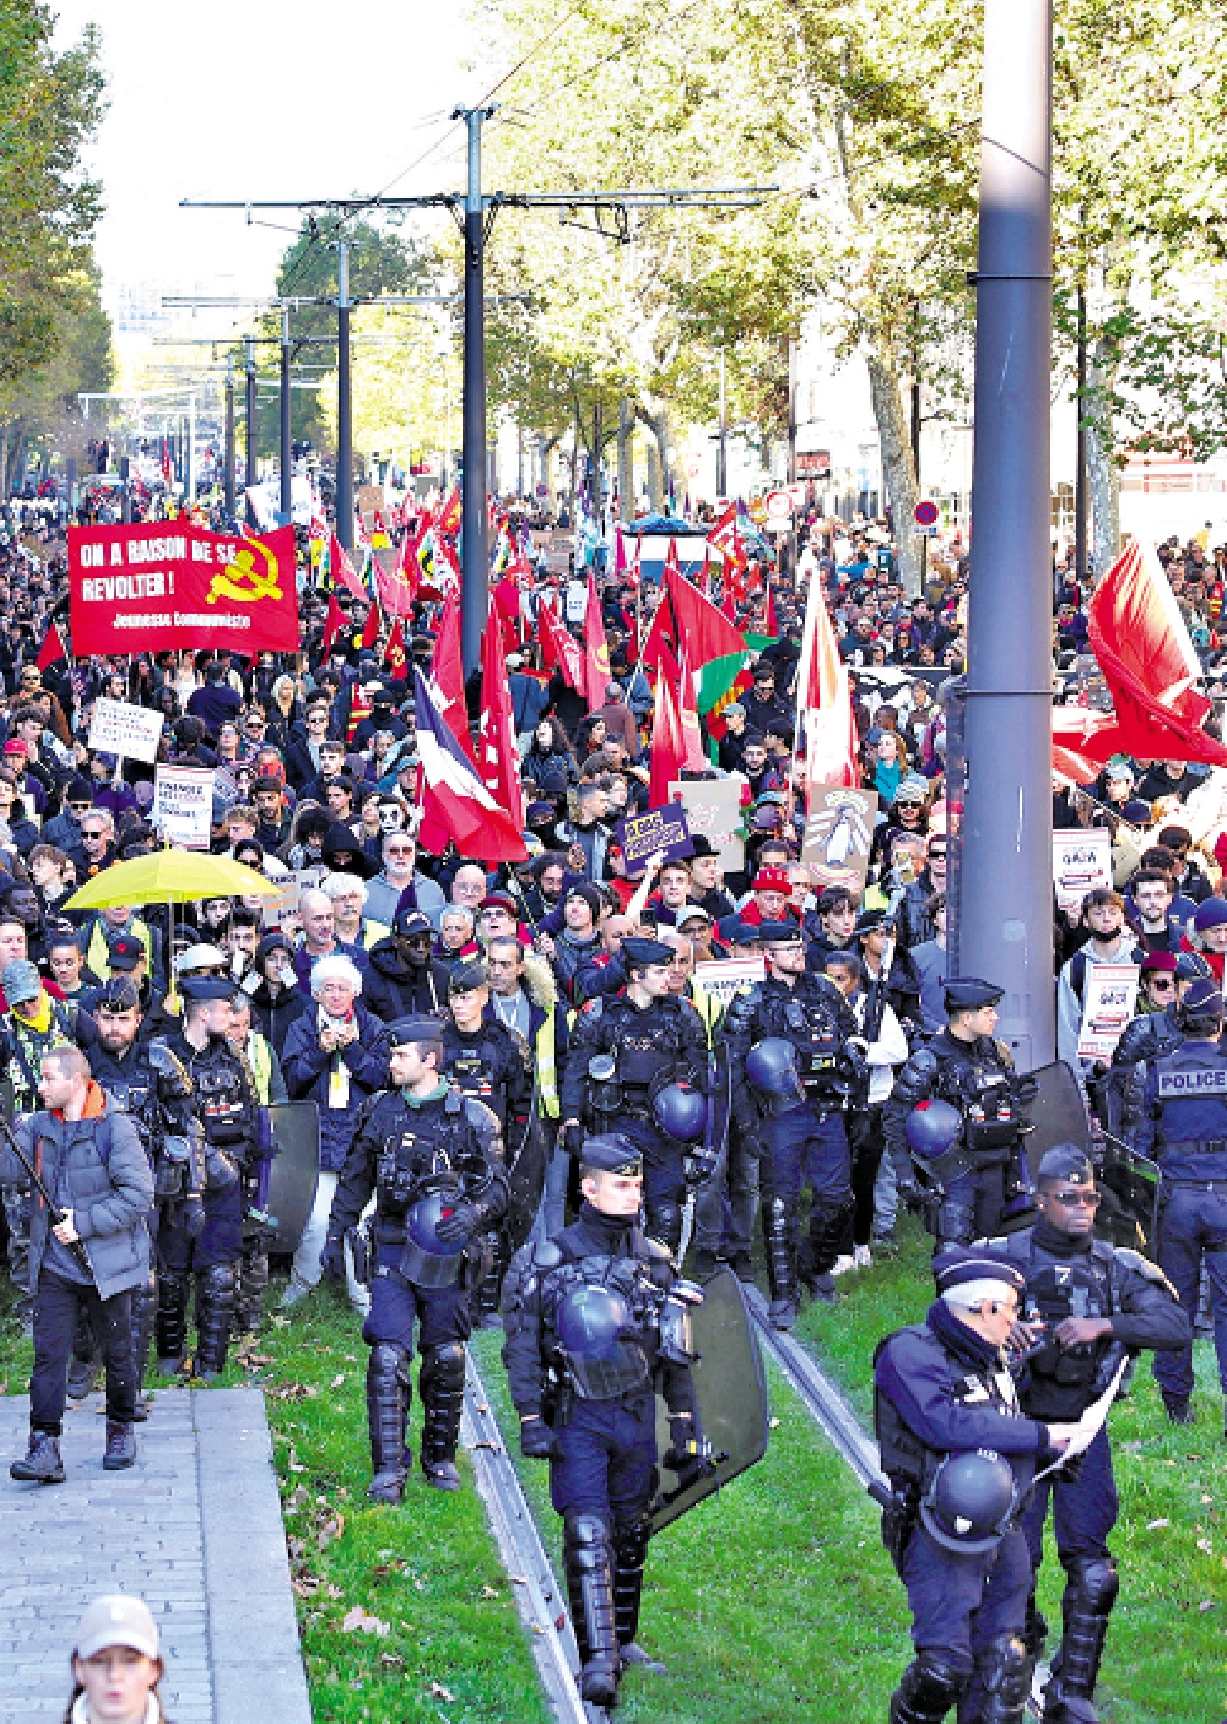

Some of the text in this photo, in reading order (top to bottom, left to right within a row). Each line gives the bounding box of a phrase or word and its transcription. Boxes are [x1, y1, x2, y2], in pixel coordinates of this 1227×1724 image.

[80, 537, 238, 567] ON A RAISON DE SE
[82, 571, 175, 601] REVOLTER !
[113, 611, 251, 629] Jeunesse Communiste
[1161, 1071, 1226, 1091] POLICE
